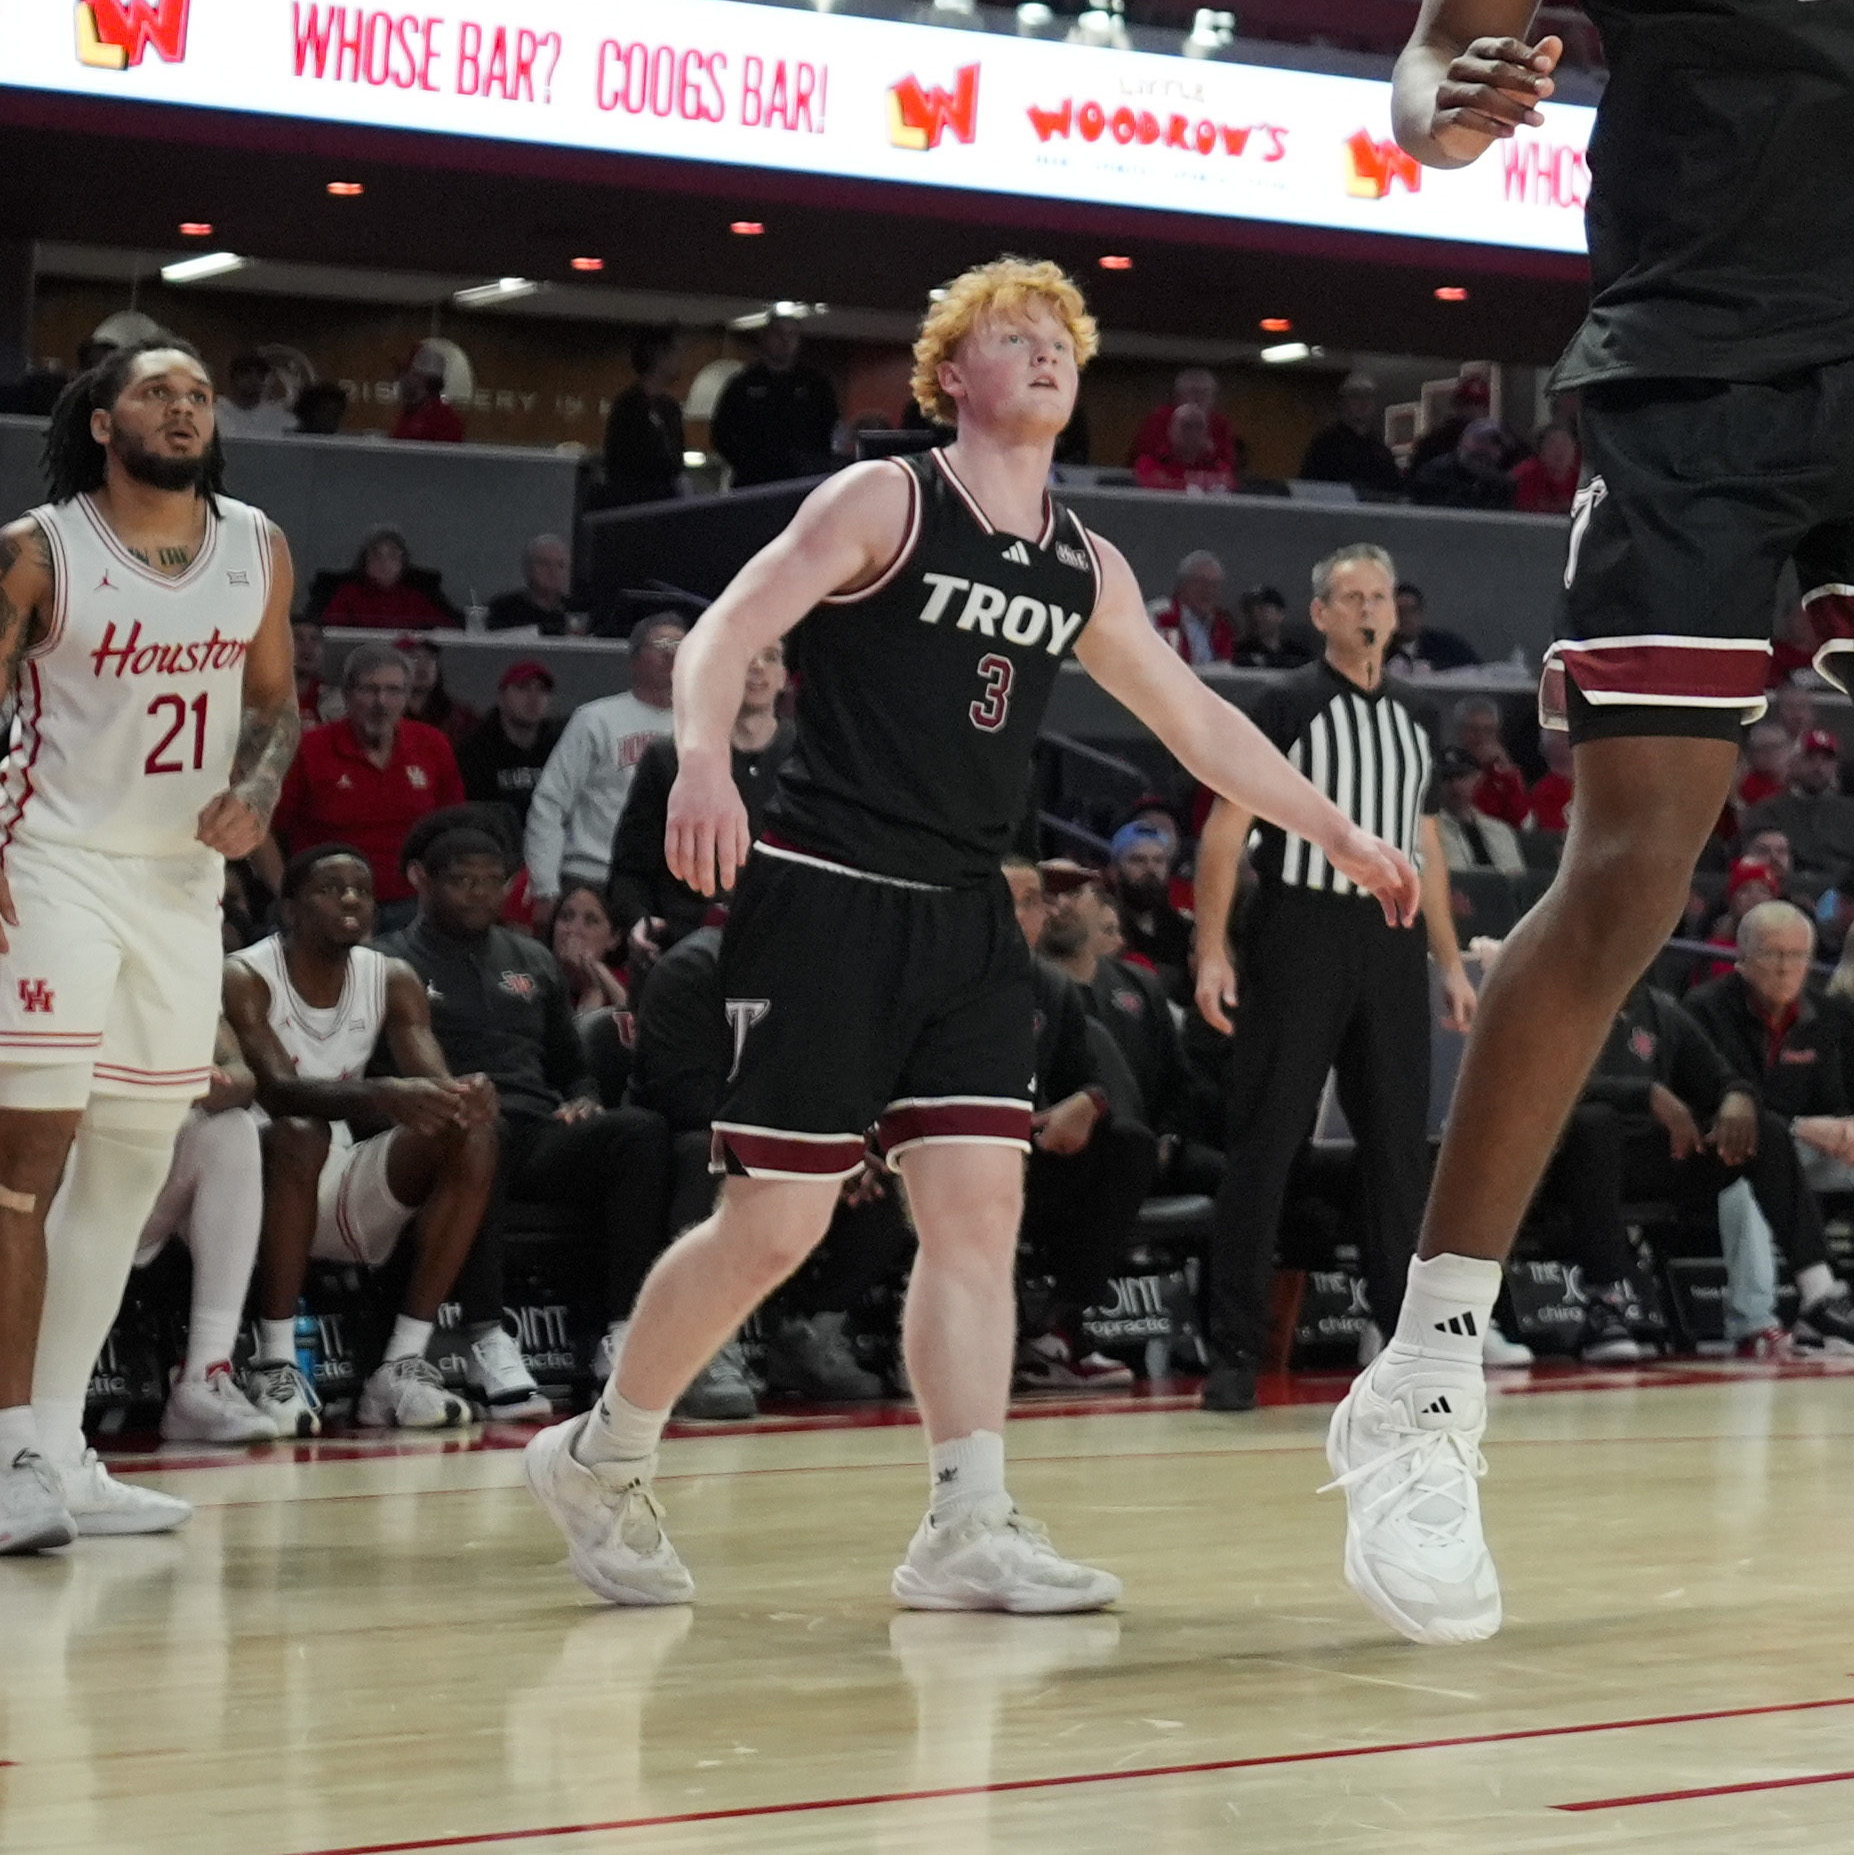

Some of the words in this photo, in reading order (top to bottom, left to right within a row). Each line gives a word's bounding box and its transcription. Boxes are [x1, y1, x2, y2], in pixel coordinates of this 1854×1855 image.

[292, 0, 445, 95] WHOSE
[457, 20, 563, 106] BAR?
[597, 38, 729, 125] COOGS
[740, 56, 829, 136] BAR!
[1025, 94, 1291, 164] WOODROW'S
[919, 571, 1082, 657] TROY
[144, 691, 208, 776] 21
[969, 652, 1014, 733] 3
